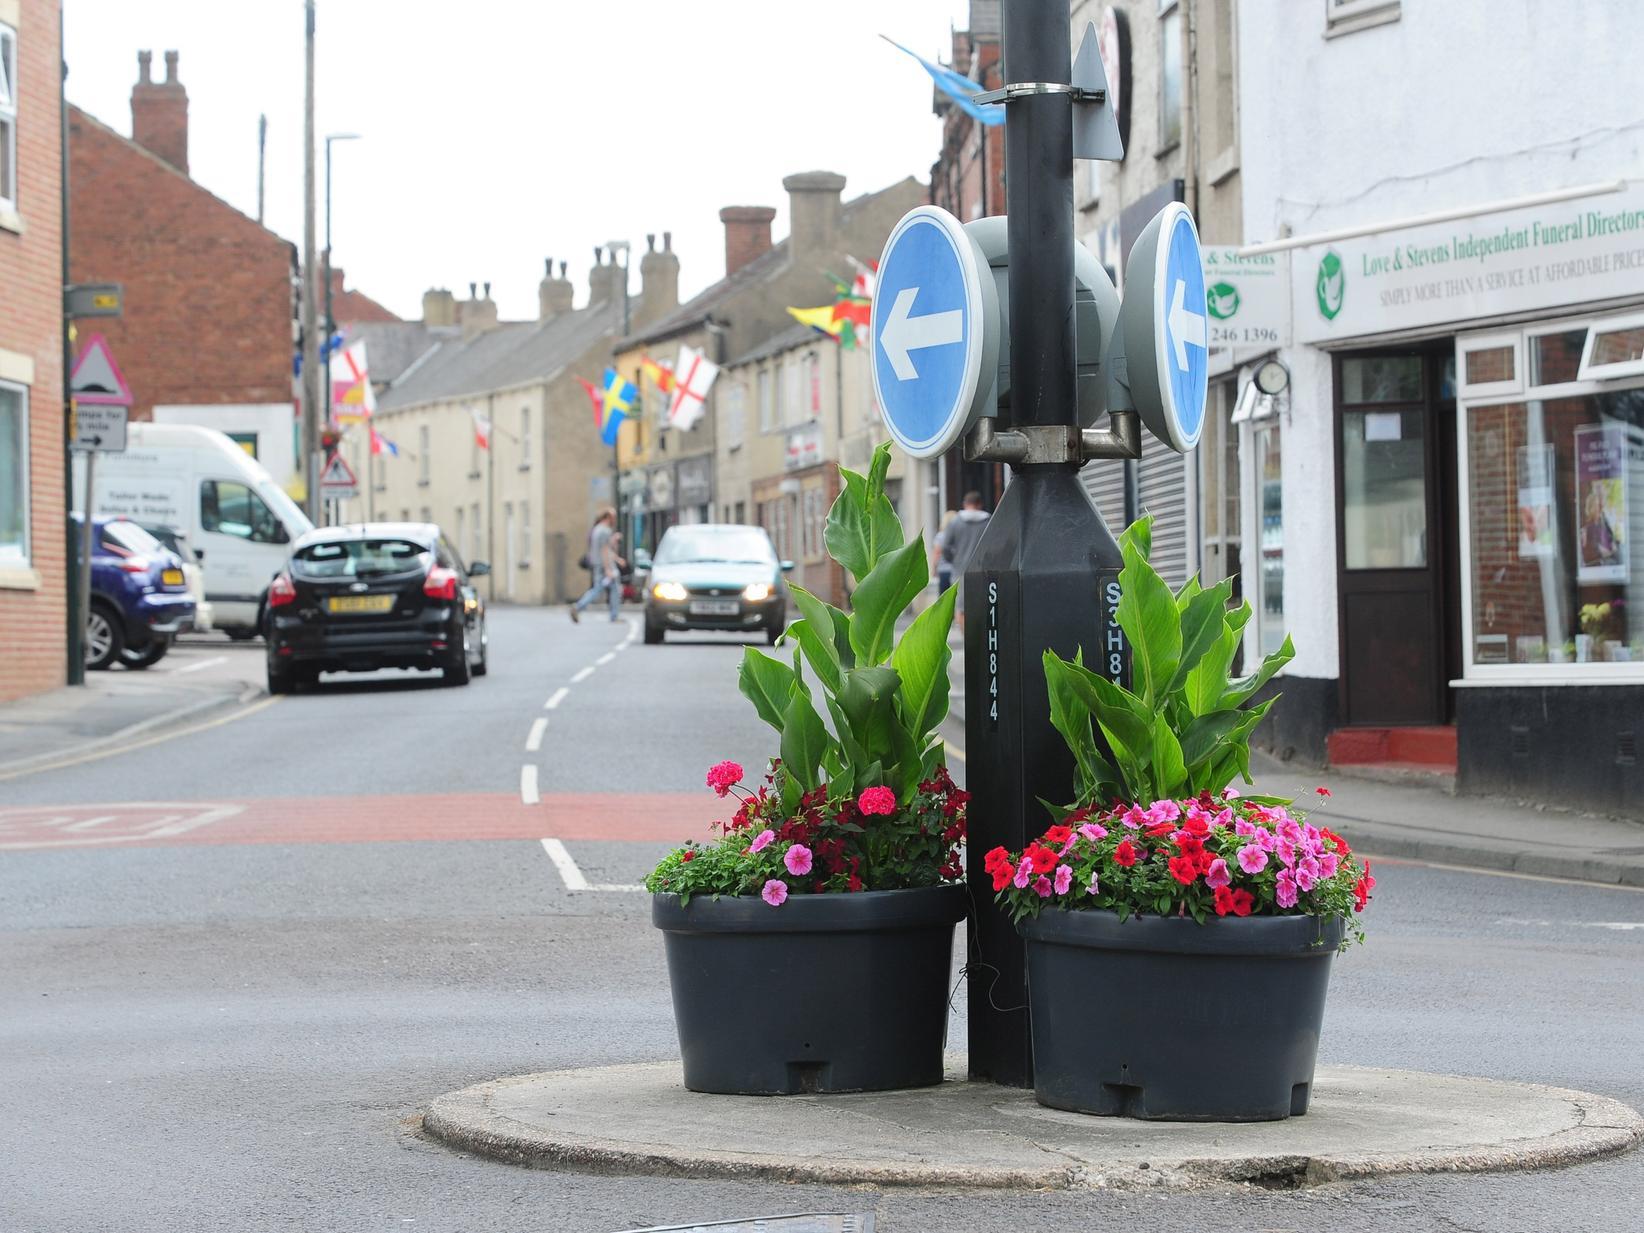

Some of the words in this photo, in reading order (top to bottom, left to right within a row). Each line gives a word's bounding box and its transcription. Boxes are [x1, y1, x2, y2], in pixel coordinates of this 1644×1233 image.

[1207, 251, 1218, 265] &
[1223, 249, 1276, 265] Stevens
[1362, 251, 1390, 277] Love
[1392, 248, 1403, 271] &
[1406, 240, 1450, 268] Stevens
[1453, 227, 1529, 263] Independent
[1533, 215, 1583, 246] Funeral
[1380, 290, 1411, 307] SIMPLY
[1415, 282, 1442, 300] MORE
[1444, 276, 1474, 298] THAN
[1477, 276, 1485, 292] A
[1486, 271, 1524, 291] SERVICE
[1526, 266, 1542, 285] AT
[1544, 255, 1610, 282] AFFORDABLE
[1211, 327, 1239, 342] 246
[1243, 327, 1279, 342] 1396
[988, 582, 998, 721] S1H844
